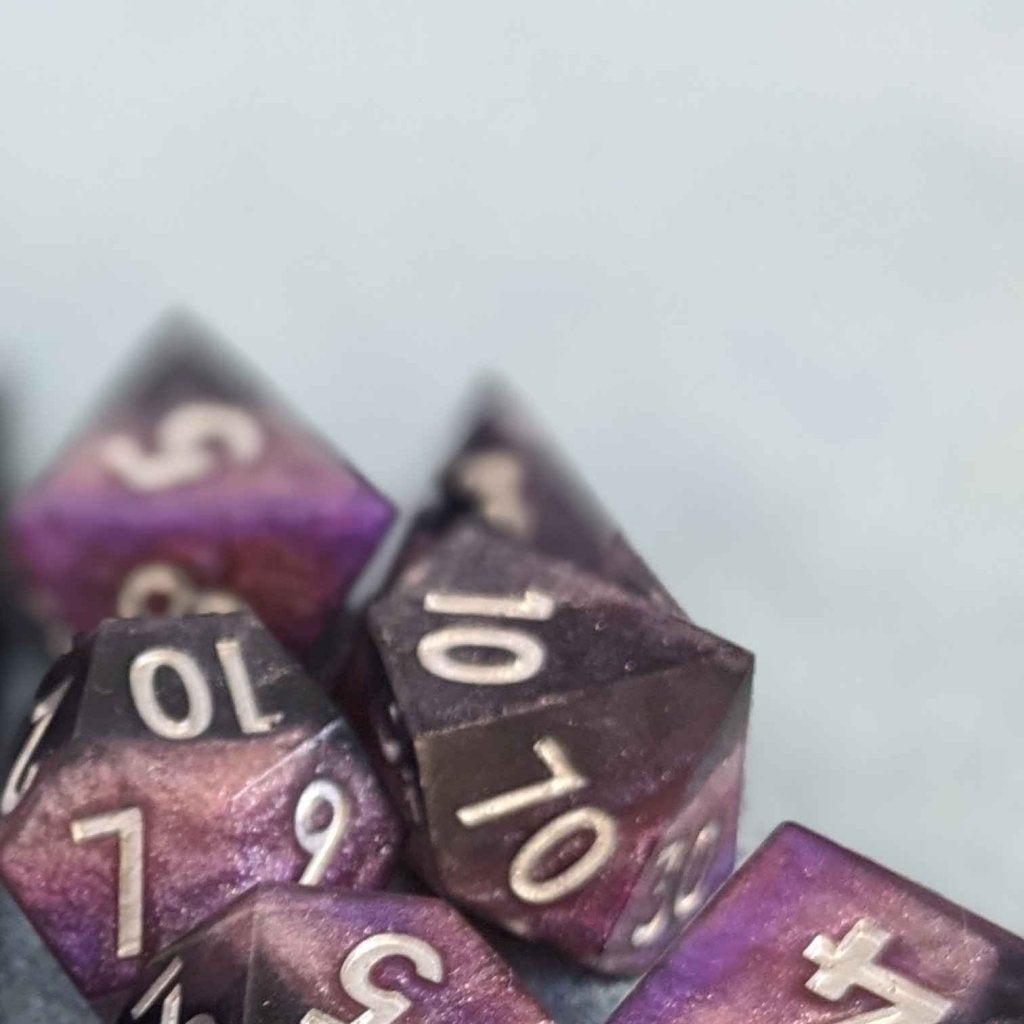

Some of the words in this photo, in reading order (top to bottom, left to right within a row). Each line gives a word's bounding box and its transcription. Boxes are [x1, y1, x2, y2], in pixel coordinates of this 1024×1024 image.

[128, 637, 285, 741] 10
[417, 589, 556, 685] 10
[71, 806, 144, 959] 7
